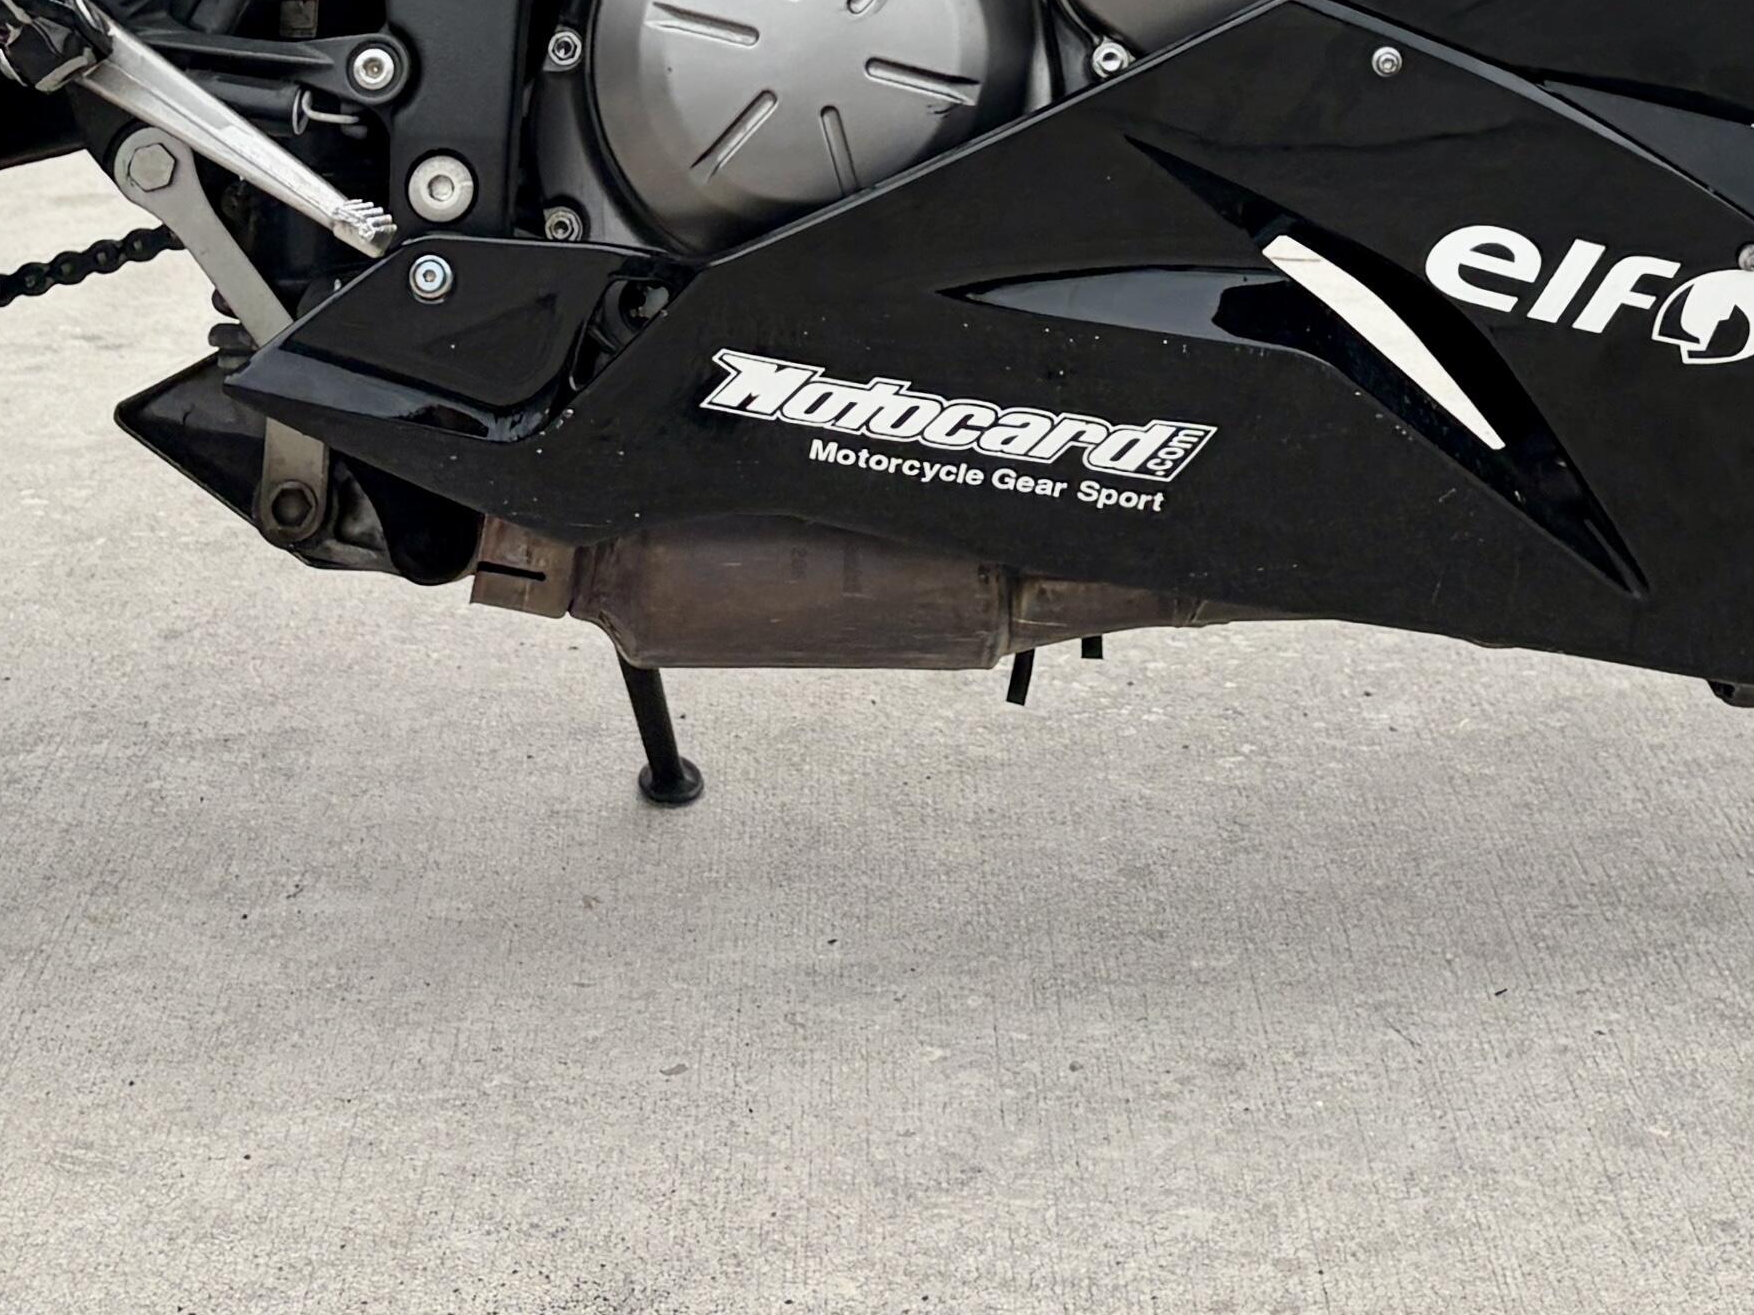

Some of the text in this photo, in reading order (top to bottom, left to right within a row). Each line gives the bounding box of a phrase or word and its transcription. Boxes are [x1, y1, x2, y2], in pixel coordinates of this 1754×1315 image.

[1425, 225, 1681, 333] elf
[810, 439, 1164, 512] Motorcycle Gear Sport
